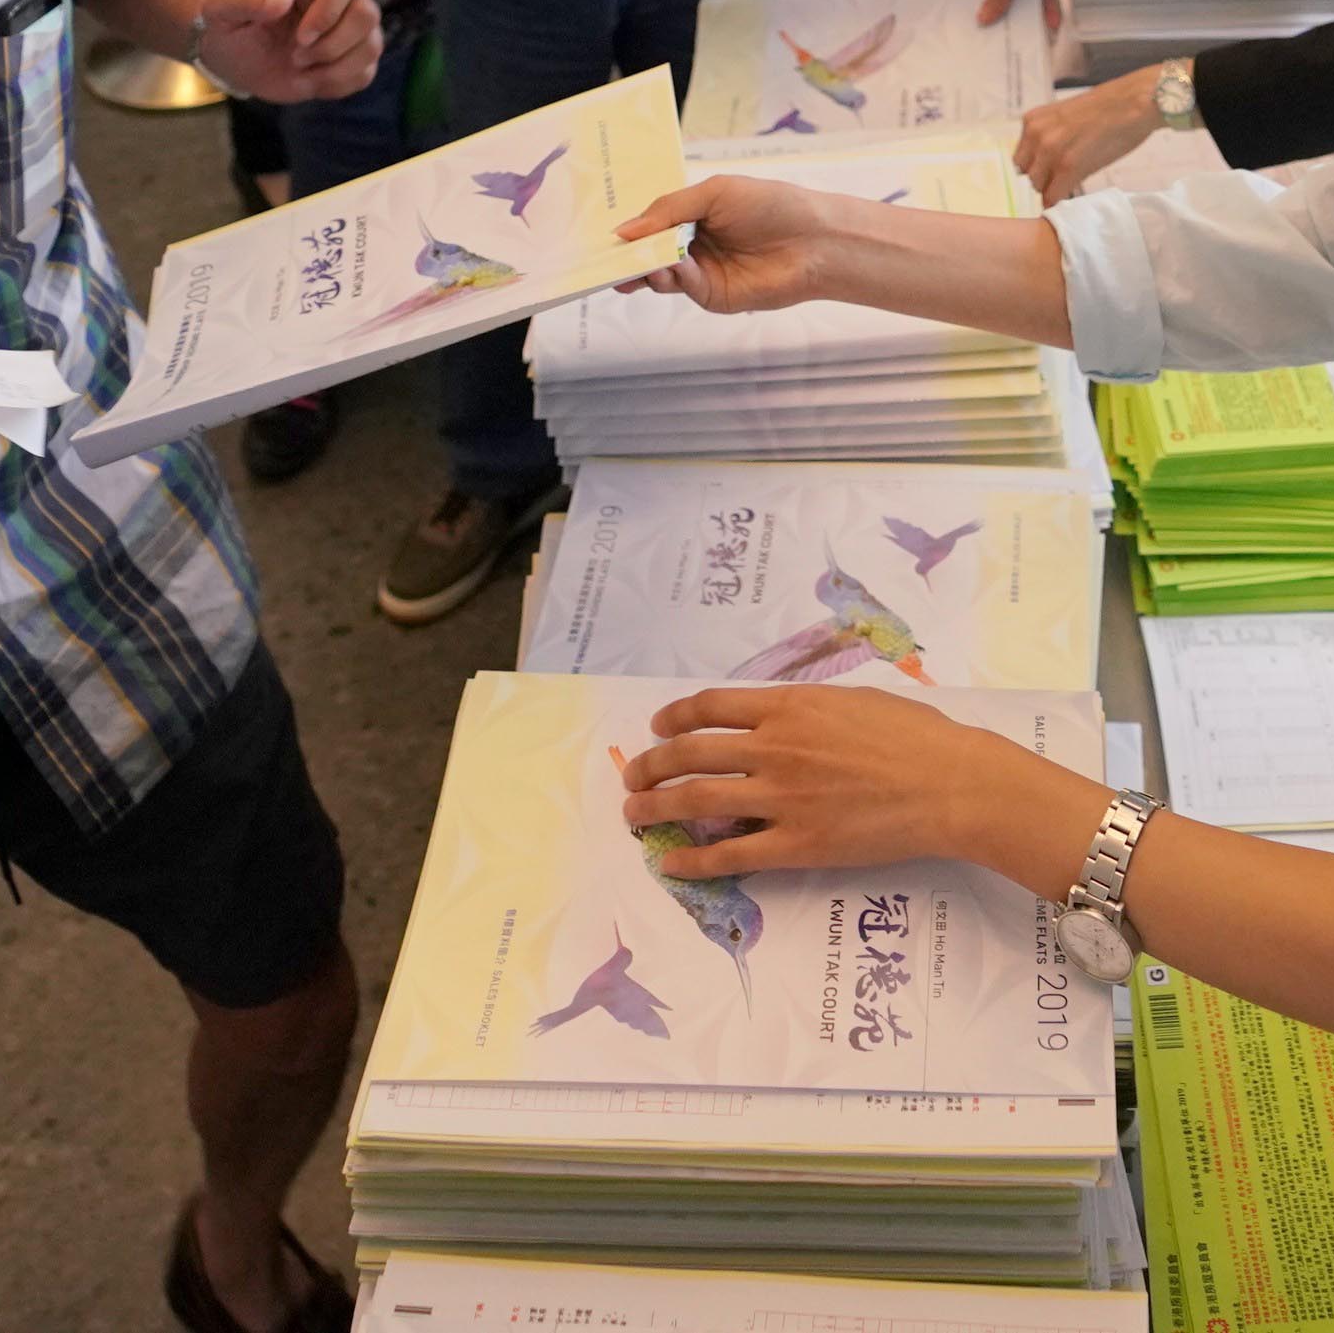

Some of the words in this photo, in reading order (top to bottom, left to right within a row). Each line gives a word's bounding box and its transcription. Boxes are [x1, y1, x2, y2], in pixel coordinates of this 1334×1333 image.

[184, 263, 215, 310] 2019
[591, 504, 623, 554] 2019
[761, 513, 776, 551] COURT
[757, 551, 771, 572] TAK
[750, 572, 766, 605] KWUN
[1035, 715, 1045, 739] SALE
[827, 899, 845, 946] KWUN
[935, 900, 948, 931] 何文田
[934, 934, 947, 952] Ho
[1036, 927, 1047, 965] FLATS
[824, 951, 841, 982] TAK
[848, 893, 913, 1052] 冠德苑
[933, 955, 946, 978] Man
[1150, 969, 1164, 982] G
[486, 970, 503, 1001] SALES
[933, 981, 945, 999] Tin
[475, 1003, 495, 1048] BOOKLET
[819, 987, 838, 1044] COURT
[1037, 973, 1069, 1051] 2019
[1196, 1242, 1220, 1315] 香港房屋委員會
